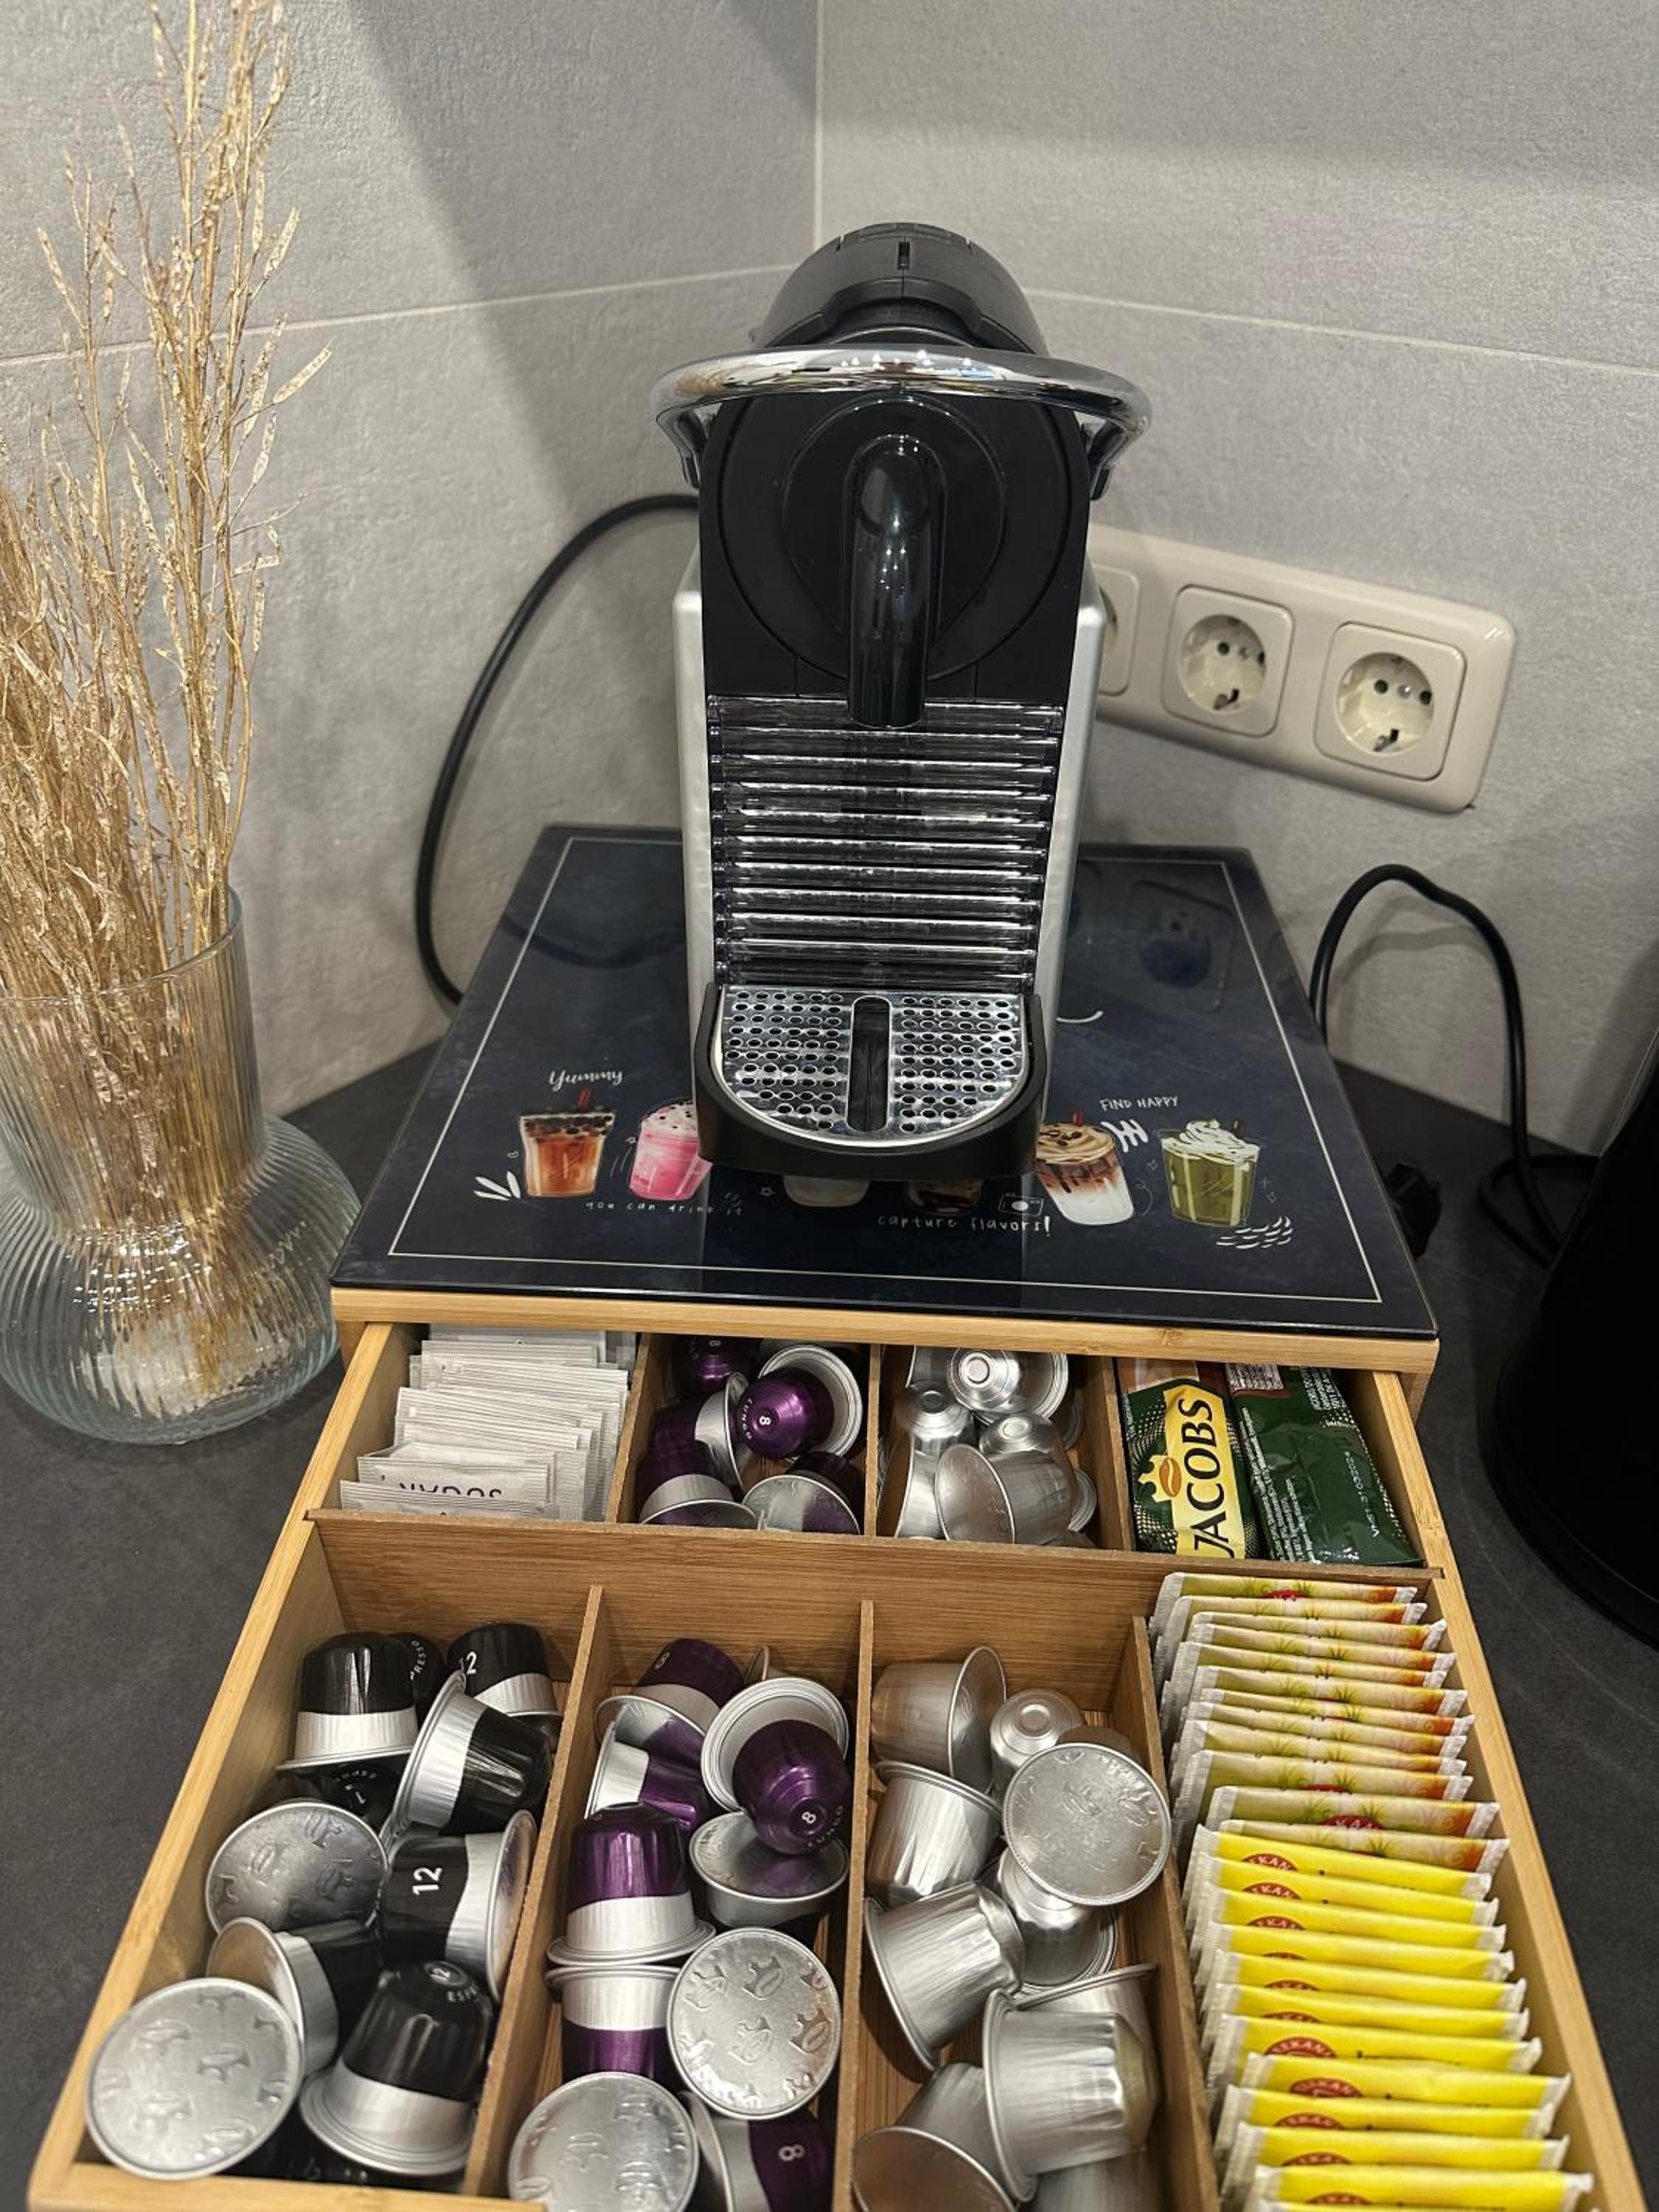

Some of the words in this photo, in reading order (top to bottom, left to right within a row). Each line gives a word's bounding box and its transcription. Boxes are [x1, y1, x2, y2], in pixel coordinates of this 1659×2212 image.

[547, 1068, 623, 1091] Yummy
[1099, 1098, 1132, 1111] FIND
[1136, 1096, 1178, 1107] HAPPY
[627, 1202, 655, 1211] can
[877, 1216, 957, 1228] capture
[971, 1215, 1051, 1237] flavors!
[759, 1416, 771, 1425] 8
[1178, 1398, 1235, 1559] JACOBS
[459, 1651, 478, 1676] 12
[801, 1811, 817, 1825] 8
[412, 1866, 442, 1896] 12
[778, 2143, 805, 2162] 8
